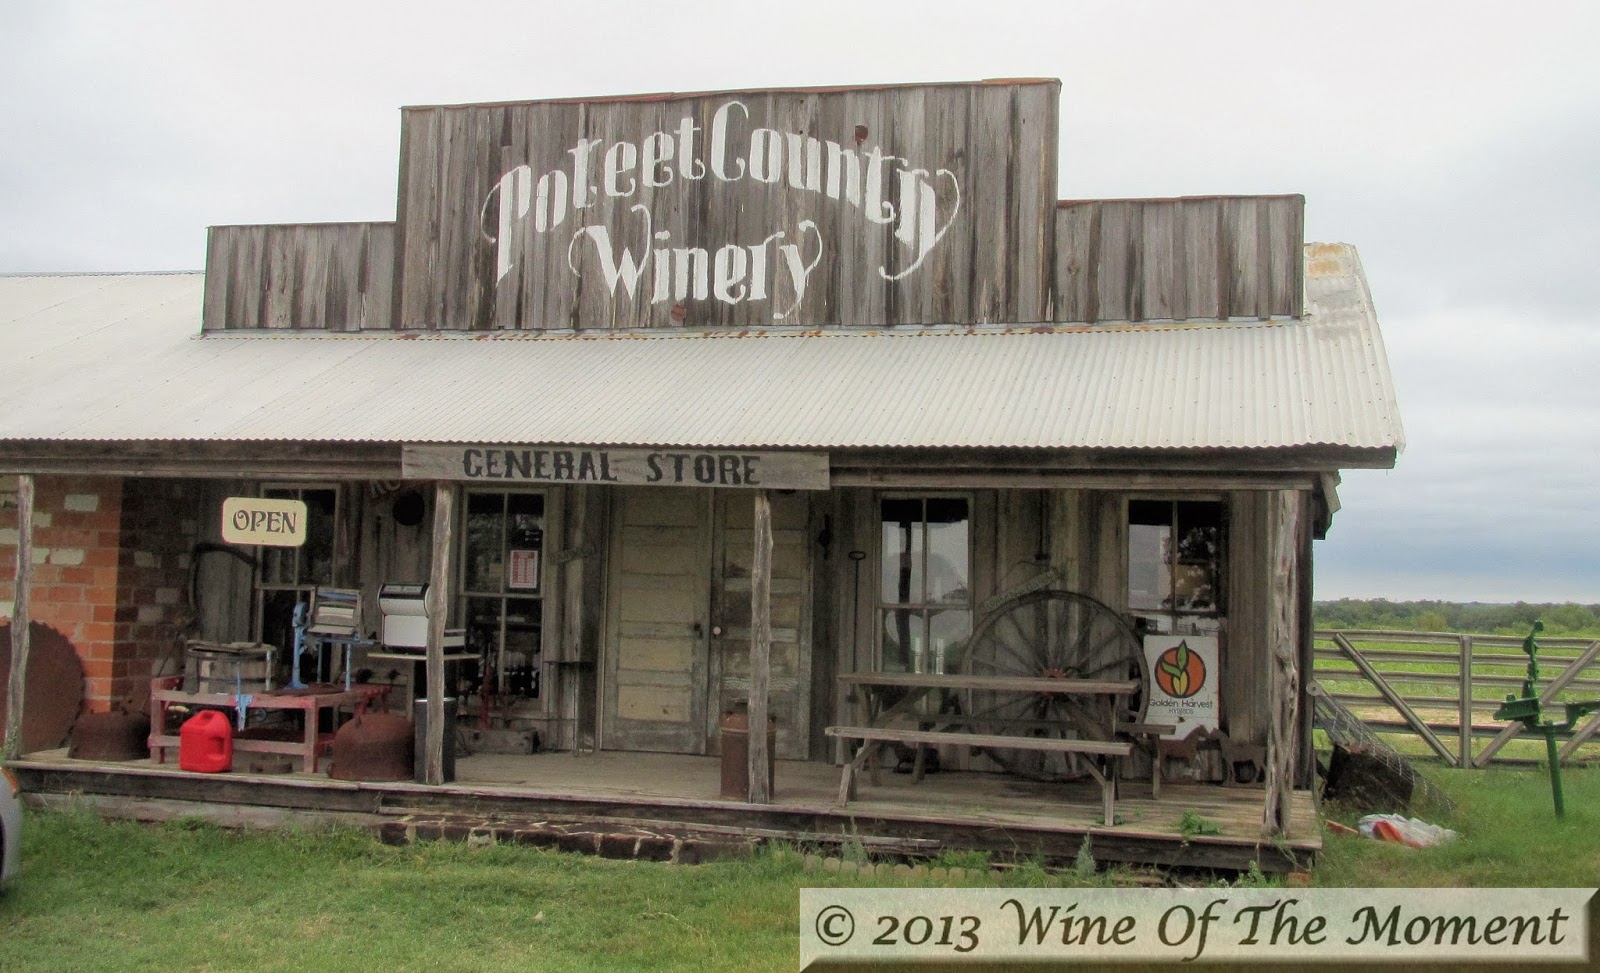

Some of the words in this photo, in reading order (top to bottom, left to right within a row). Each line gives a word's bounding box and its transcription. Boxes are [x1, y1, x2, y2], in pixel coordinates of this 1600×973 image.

[480, 116, 705, 287] Poteet
[711, 100, 960, 281] County
[568, 203, 823, 320] Winery
[463, 448, 618, 482] GENERAL
[646, 453, 761, 486] STORE
[232, 509, 298, 535] OPEN
[1149, 699, 1179, 708] Golden
[1181, 699, 1213, 709] Harvest
